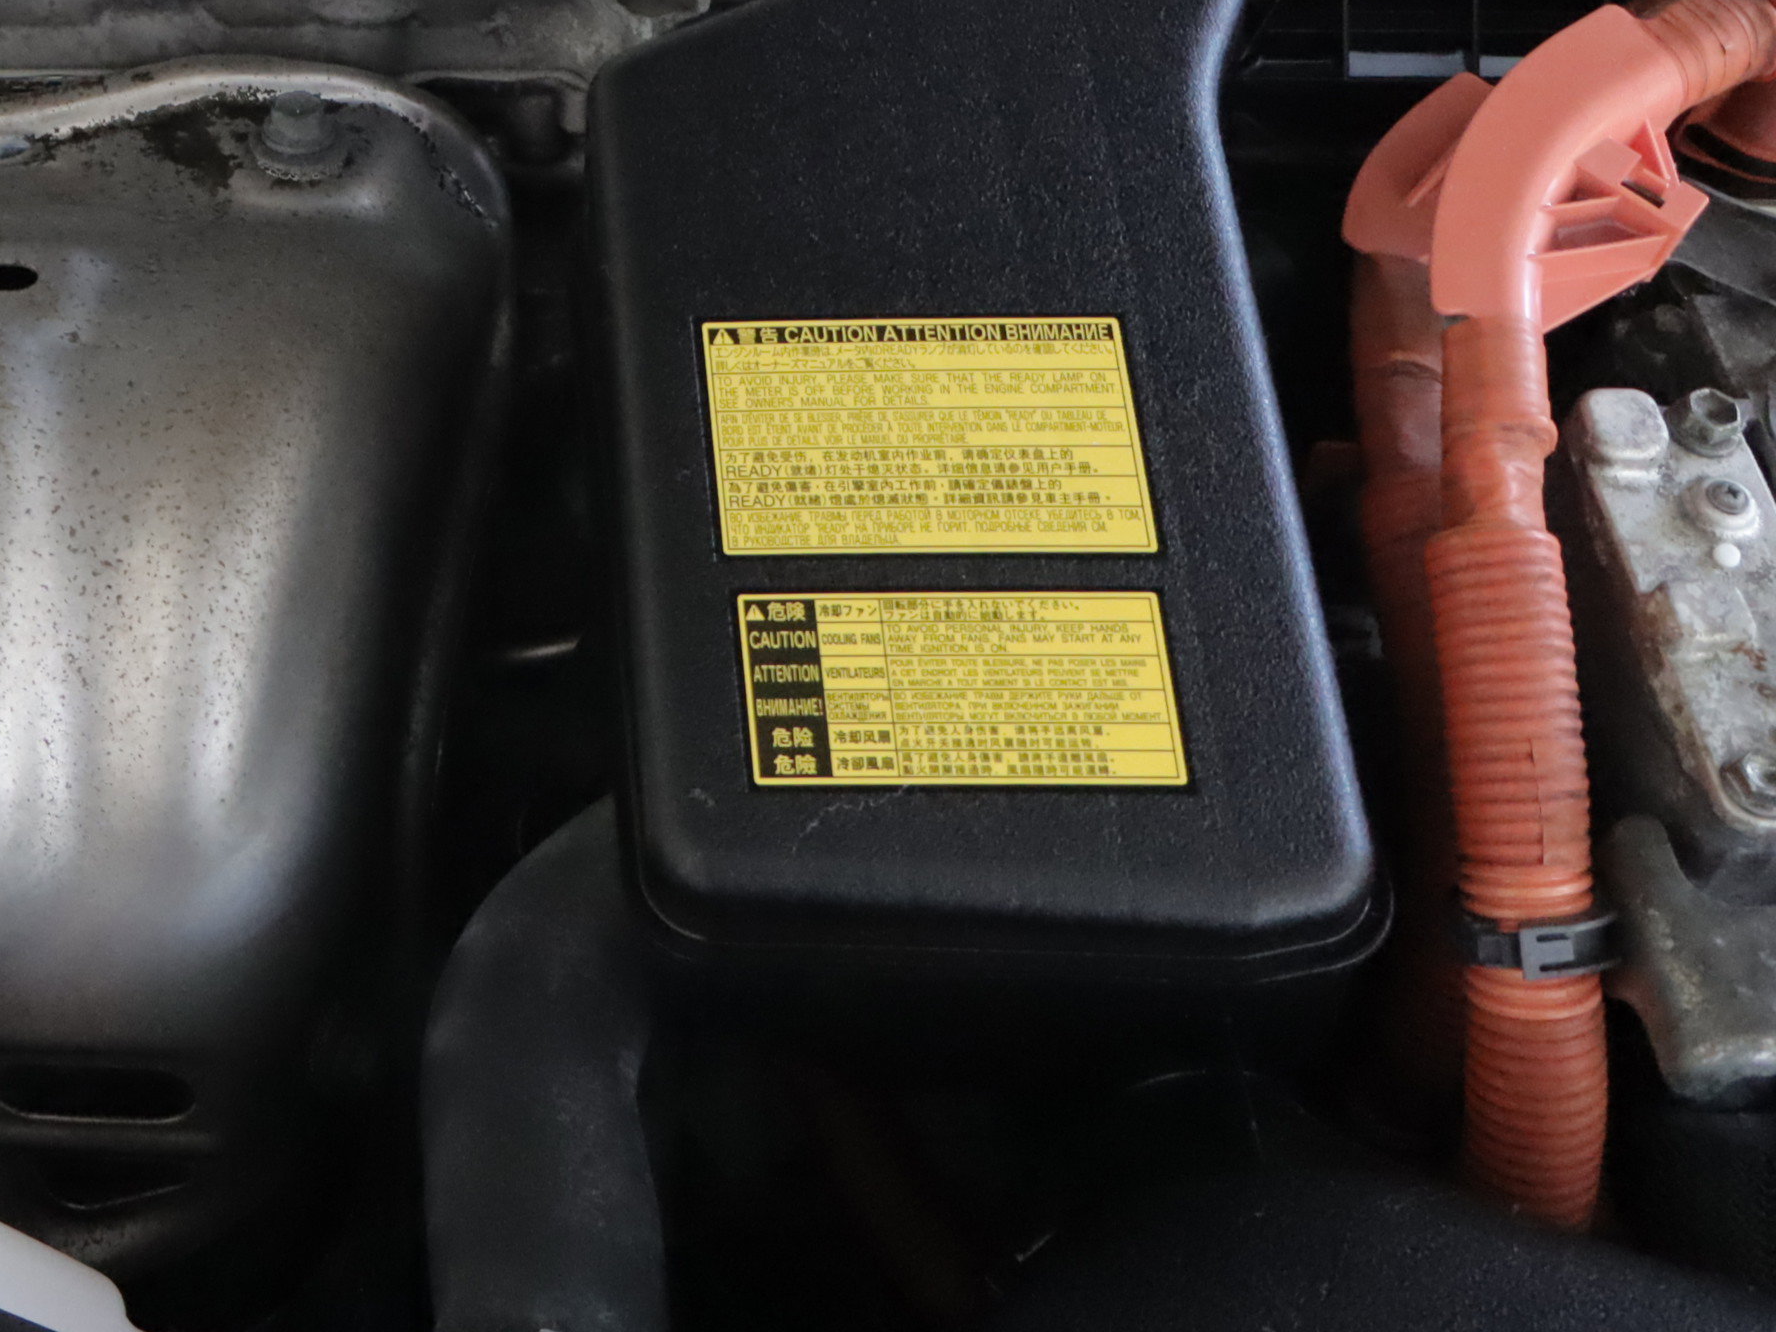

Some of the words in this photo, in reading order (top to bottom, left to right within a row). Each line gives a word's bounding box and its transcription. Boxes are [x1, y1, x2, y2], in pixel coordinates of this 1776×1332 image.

[784, 326, 877, 343] CAUTION
[882, 325, 1001, 342] ATTENTION
[1004, 323, 1111, 341] ВНИМАНИЕ
[738, 376, 773, 386] AVOID
[826, 374, 867, 385] PLEASE
[873, 374, 904, 384] MAKE
[911, 374, 940, 384] SURE
[946, 373, 975, 383] THAT
[982, 373, 1003, 383] THE
[1009, 372, 1046, 382] READY
[1052, 372, 1084, 382] LAMP
[719, 388, 739, 397] THE
[745, 387, 783, 396] METER
[804, 387, 826, 396] OFF
[832, 386, 875, 395] BEFORE
[882, 385, 934, 395] WORKING
[957, 385, 978, 394] THE
[984, 384, 1024, 394] ENGINE
[719, 399, 739, 408] SEE
[800, 397, 847, 407] MANUAL
[853, 397, 877, 407] FOR
[818, 604, 877, 617] 冷却ファン
[906, 625, 939, 633] AVOID
[1055, 624, 1085, 632] KEEP
[749, 631, 816, 648] CAUTION
[822, 634, 857, 644] COOLING
[861, 634, 881, 644] FANS
[887, 635, 917, 643] AWAY
[923, 635, 955, 643] FROM
[998, 634, 1026, 642] FANS
[1061, 634, 1095, 642] START
[1119, 634, 1142, 642] ANY
[888, 645, 914, 653] TIME
[920, 644, 969, 652] IGNITION
[753, 665, 820, 682] ATTENTION
[825, 667, 885, 678] VENTILATEURS
[756, 699, 824, 716] ВНИМАНИЕ!
[772, 727, 814, 747] 危险
